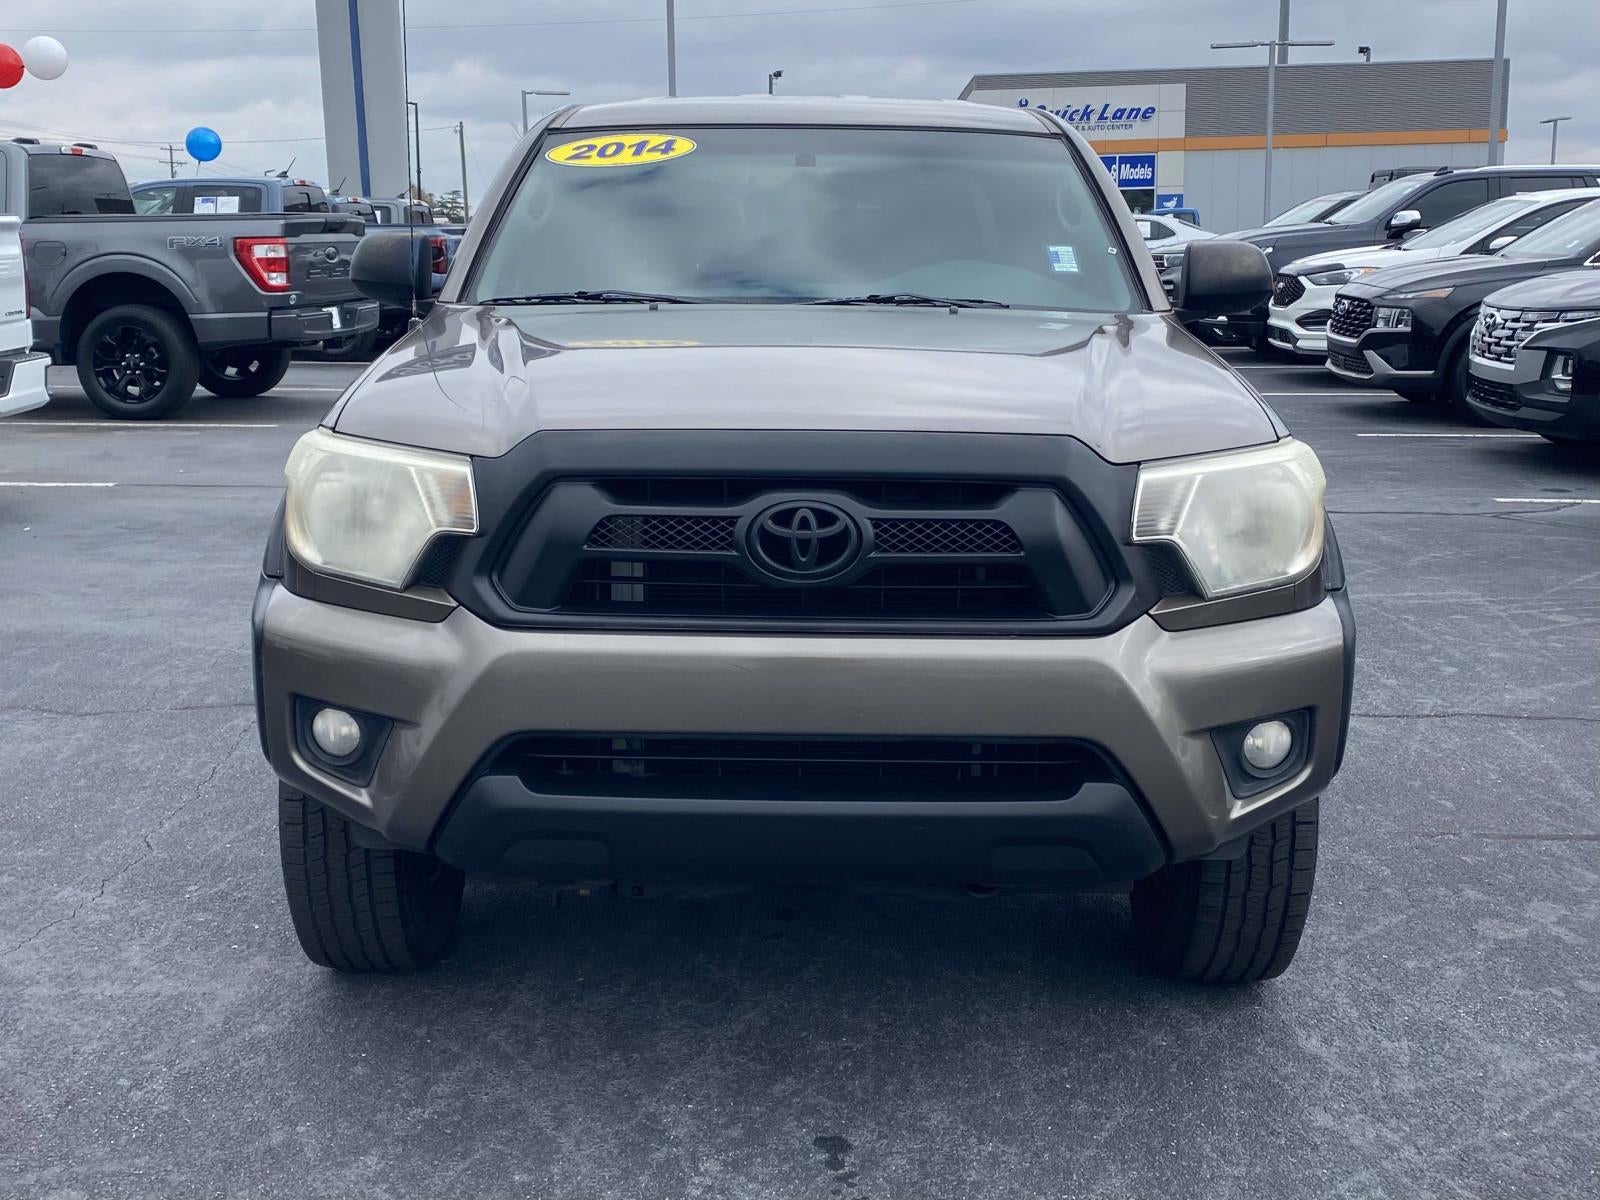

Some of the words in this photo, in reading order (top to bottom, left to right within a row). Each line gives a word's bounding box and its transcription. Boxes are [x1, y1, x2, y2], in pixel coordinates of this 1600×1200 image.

[1036, 104, 1096, 122] ick
[1097, 103, 1156, 121] Lane
[1106, 123, 1133, 131] CENTER
[564, 138, 678, 161] 2014
[1120, 163, 1153, 180] Models
[167, 236, 224, 250] FX4
